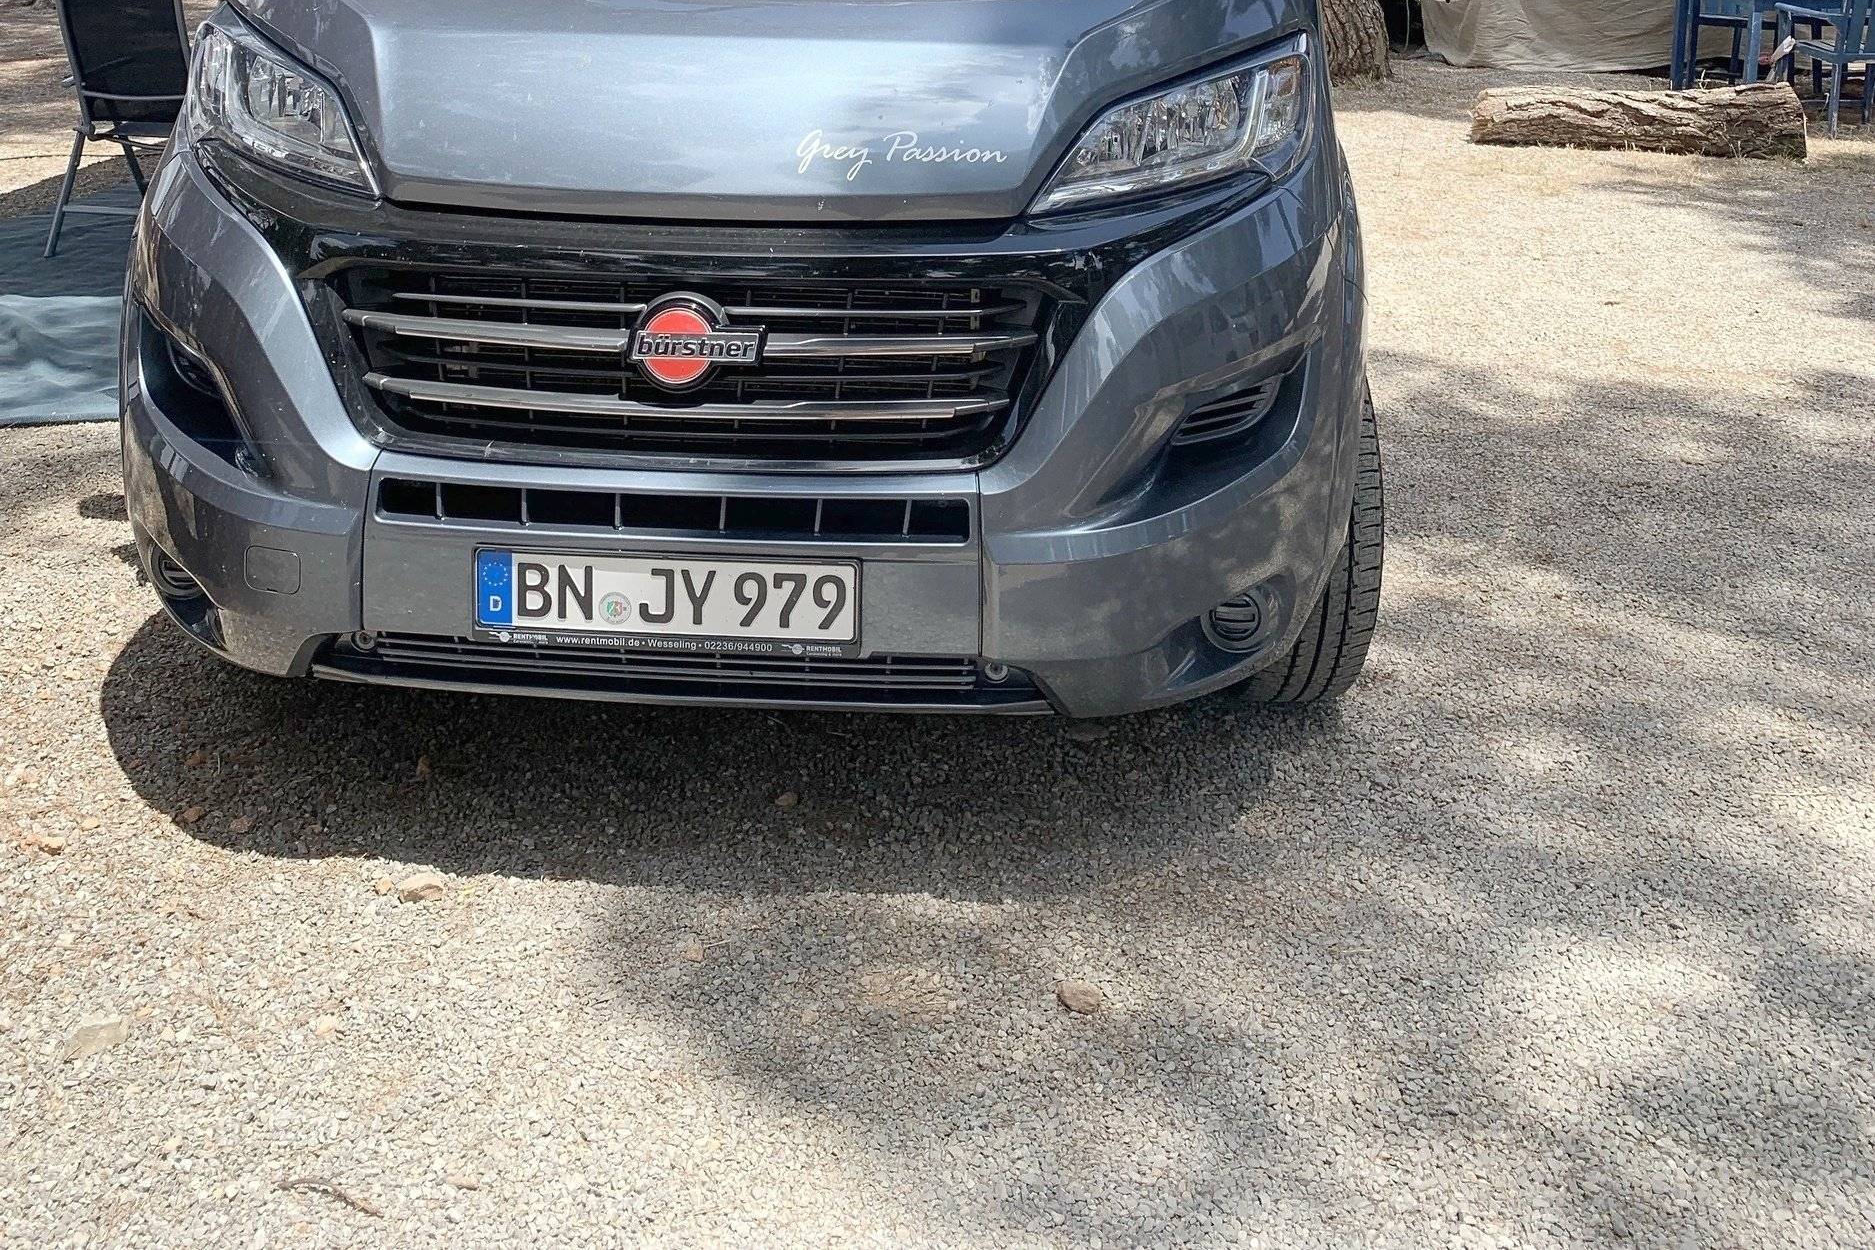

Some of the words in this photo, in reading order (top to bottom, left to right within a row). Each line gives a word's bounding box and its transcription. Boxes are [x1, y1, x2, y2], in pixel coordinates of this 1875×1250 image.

[797, 129, 872, 181] Grey
[883, 130, 1008, 163] Passion
[638, 333, 755, 358] bürstner
[489, 595, 502, 611] D
[517, 562, 593, 620] BN
[639, 568, 716, 625] JY
[734, 572, 846, 630] 979
[556, 634, 640, 647] www.rentmobil.de
[648, 638, 697, 650] Wesseling
[704, 641, 773, 652] 02236/944900
